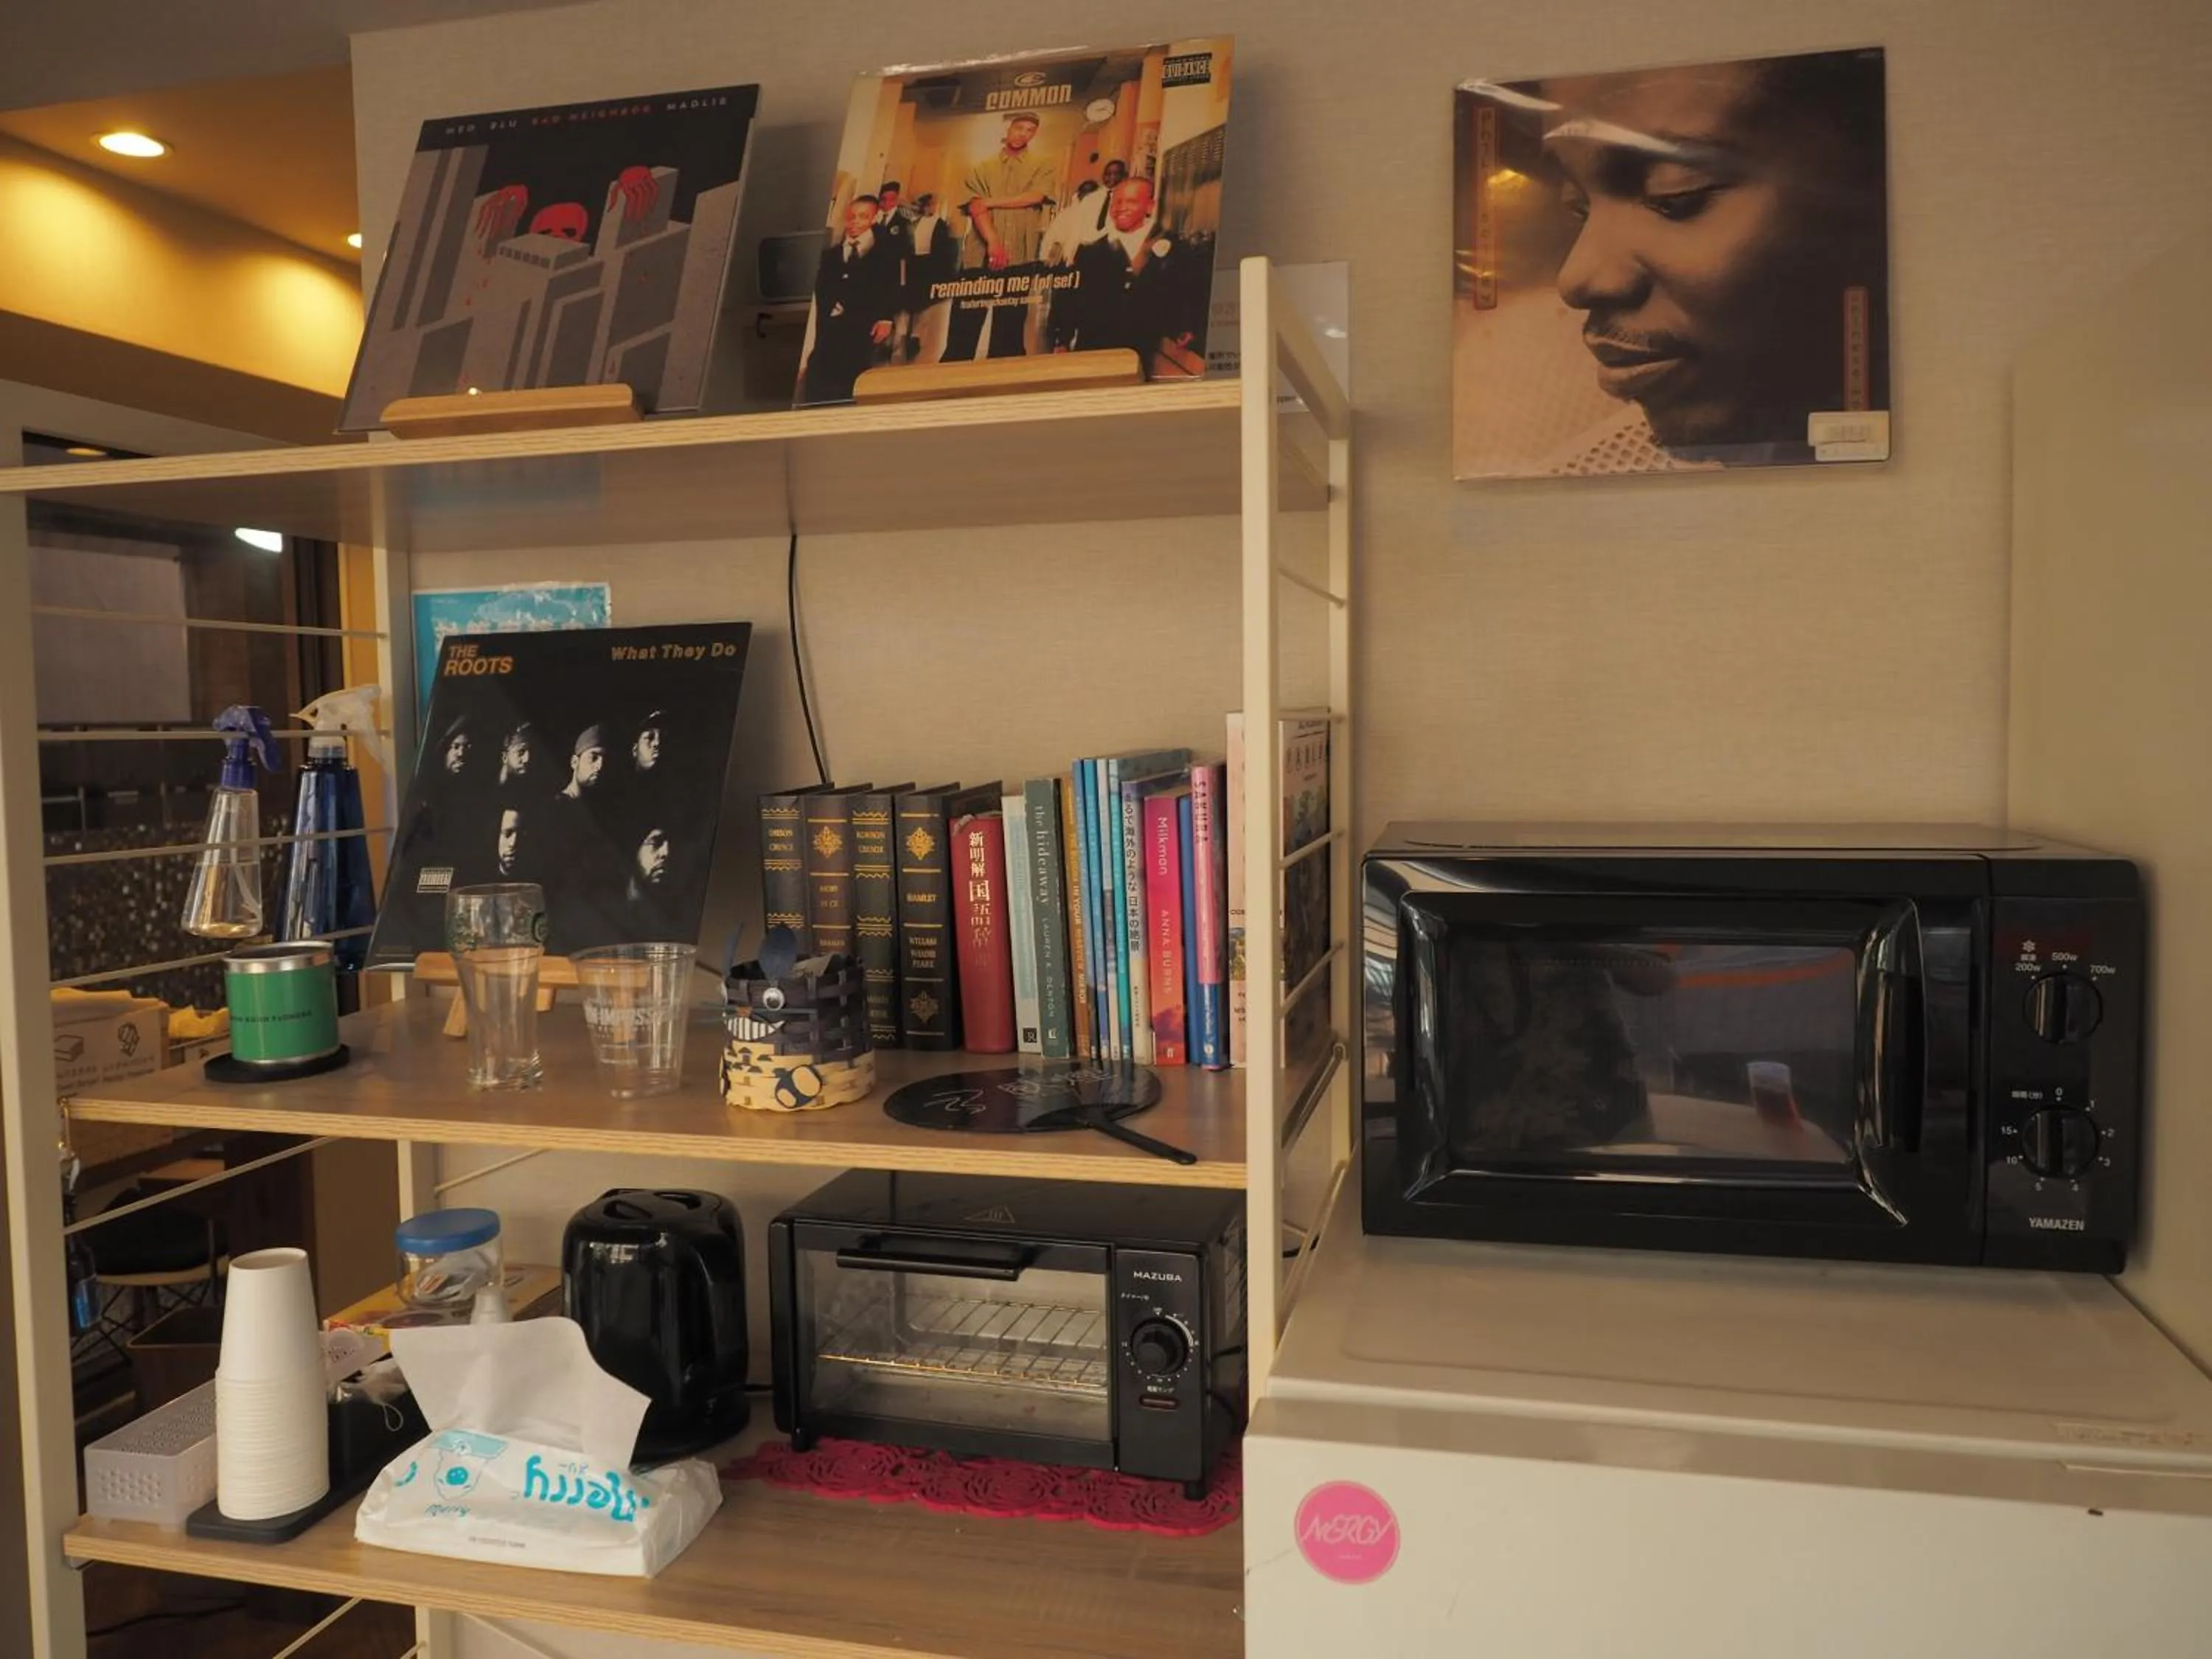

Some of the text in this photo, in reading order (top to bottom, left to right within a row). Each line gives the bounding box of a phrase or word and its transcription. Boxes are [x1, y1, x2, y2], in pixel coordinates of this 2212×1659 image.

[667, 97, 728, 110] MADLIB
[986, 84, 1072, 111] COMMON
[930, 275, 1005, 299] reminding
[1007, 275, 1031, 293] me
[448, 644, 479, 658] THE
[611, 641, 737, 661] What They Do
[444, 655, 514, 676] ROOTS
[1034, 804, 1050, 904] the hideaway
[1156, 817, 1169, 876] Milkman
[1161, 909, 1171, 947] ANNA
[2029, 1217, 2085, 1231] YAMAZEN
[1133, 1270, 1183, 1282] MAZUBA
